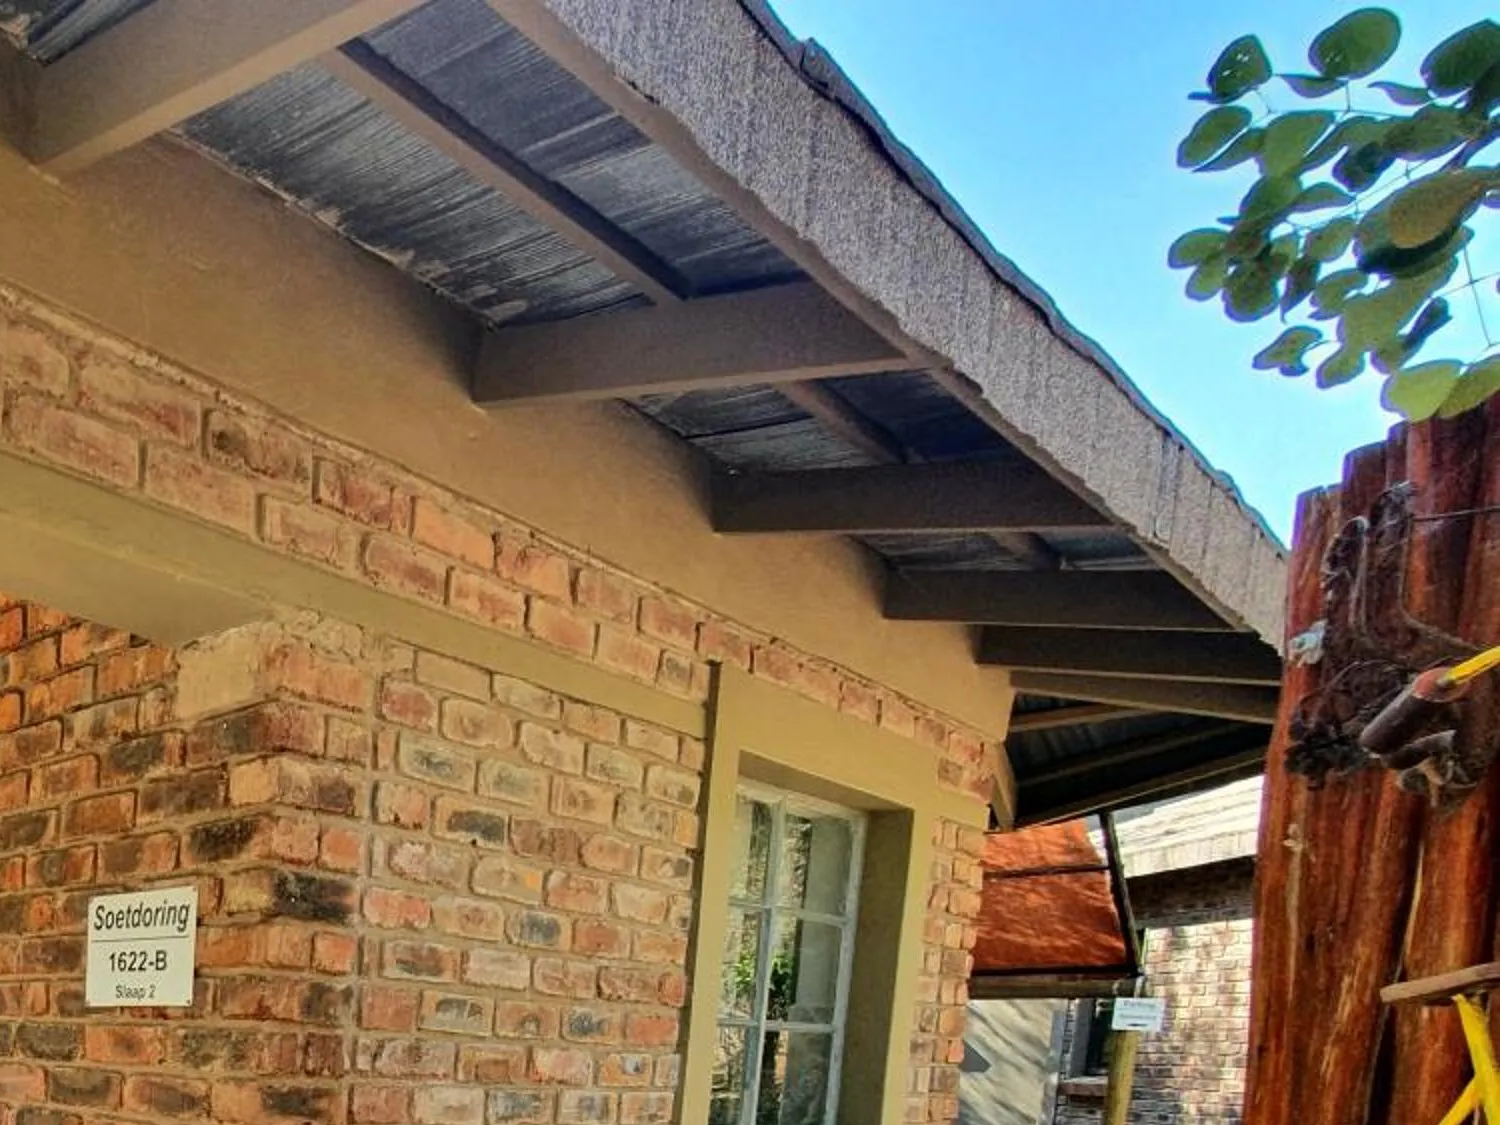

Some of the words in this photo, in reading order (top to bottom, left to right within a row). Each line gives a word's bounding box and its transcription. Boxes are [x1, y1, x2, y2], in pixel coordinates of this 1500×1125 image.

[93, 900, 190, 932] Soetdoring
[109, 950, 167, 972] 1622-B
[148, 983, 156, 998] 2
